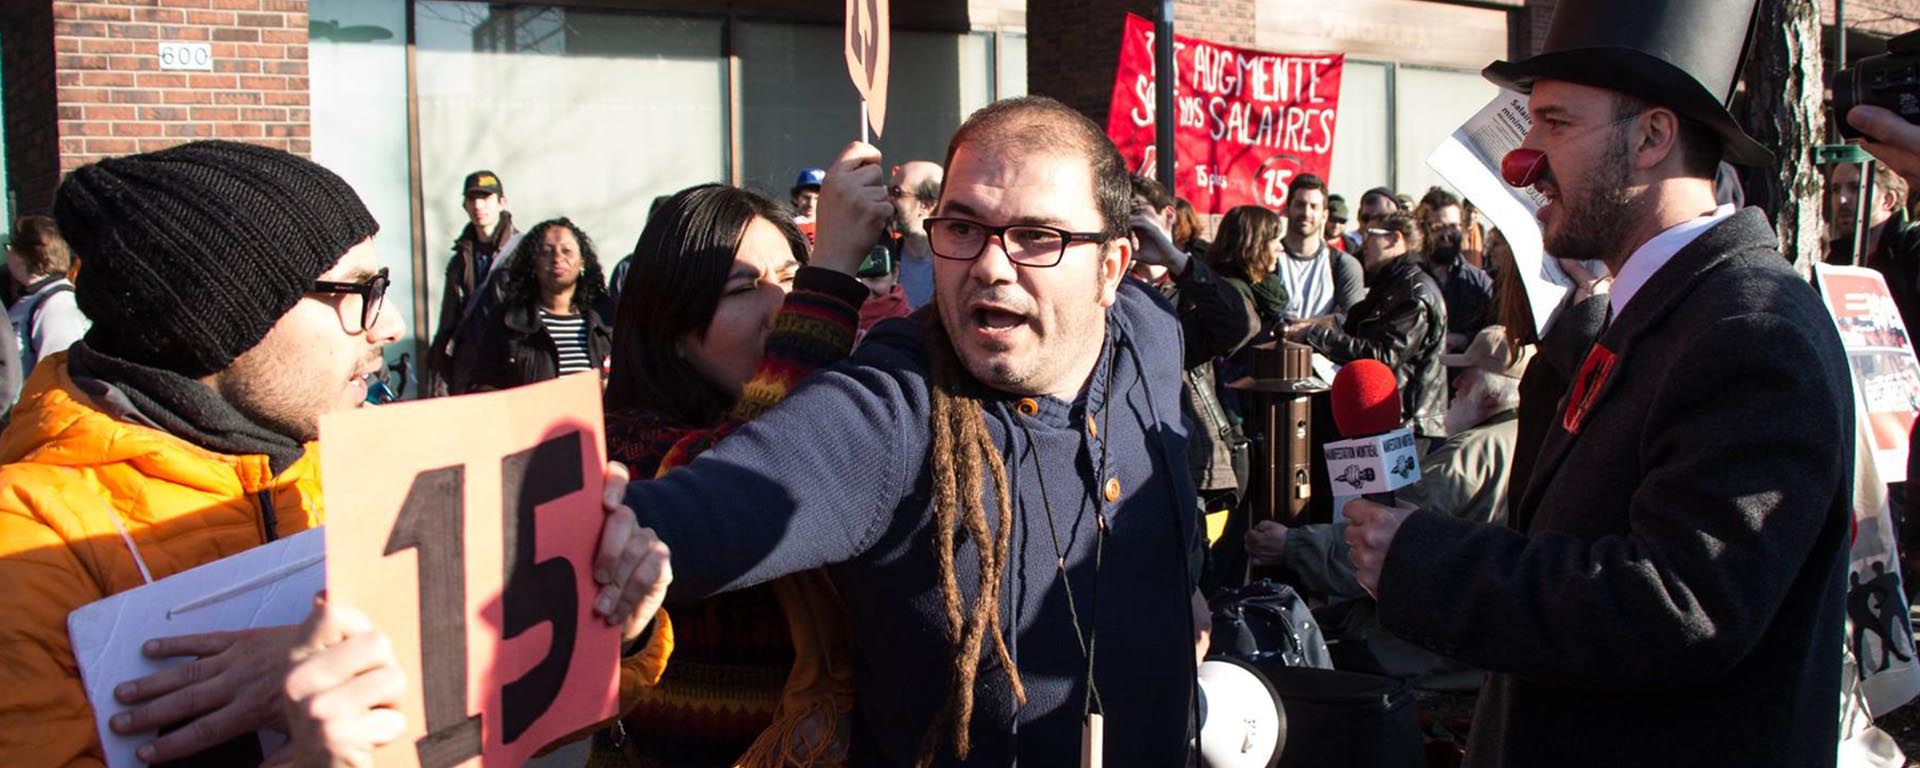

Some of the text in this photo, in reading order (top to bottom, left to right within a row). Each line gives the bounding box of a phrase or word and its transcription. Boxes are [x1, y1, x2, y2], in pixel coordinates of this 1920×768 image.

[162, 46, 208, 65] 600
[1193, 44, 1331, 103] AUGMENTE
[1208, 96, 1334, 154] SALAIRES
[1502, 108, 1528, 136] minimu
[1263, 169, 1292, 206] 15
[382, 430, 583, 768] 15
